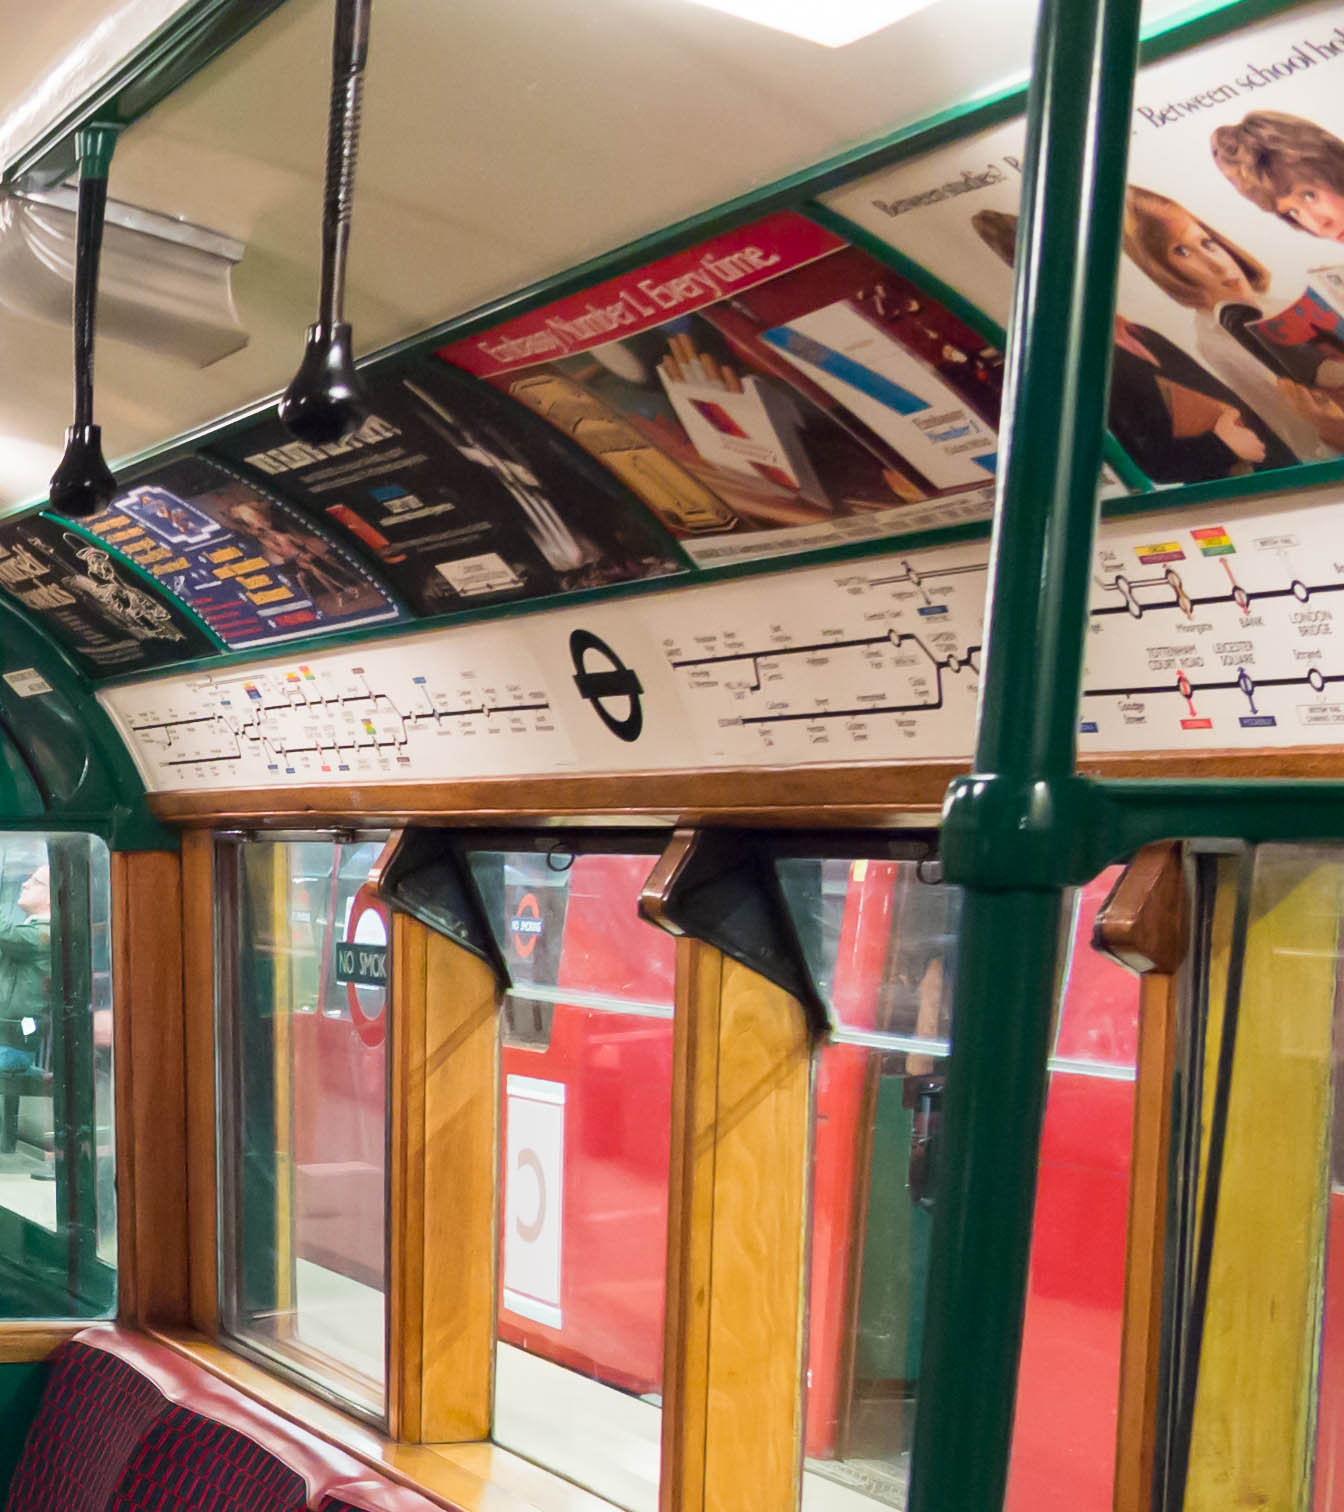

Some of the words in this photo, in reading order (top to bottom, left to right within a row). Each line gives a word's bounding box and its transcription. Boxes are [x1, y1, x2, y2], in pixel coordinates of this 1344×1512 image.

[1137, 85, 1240, 128] Between
[1235, 45, 1318, 91] school
[338, 952, 354, 975] NO
[359, 952, 388, 977] SMOK
